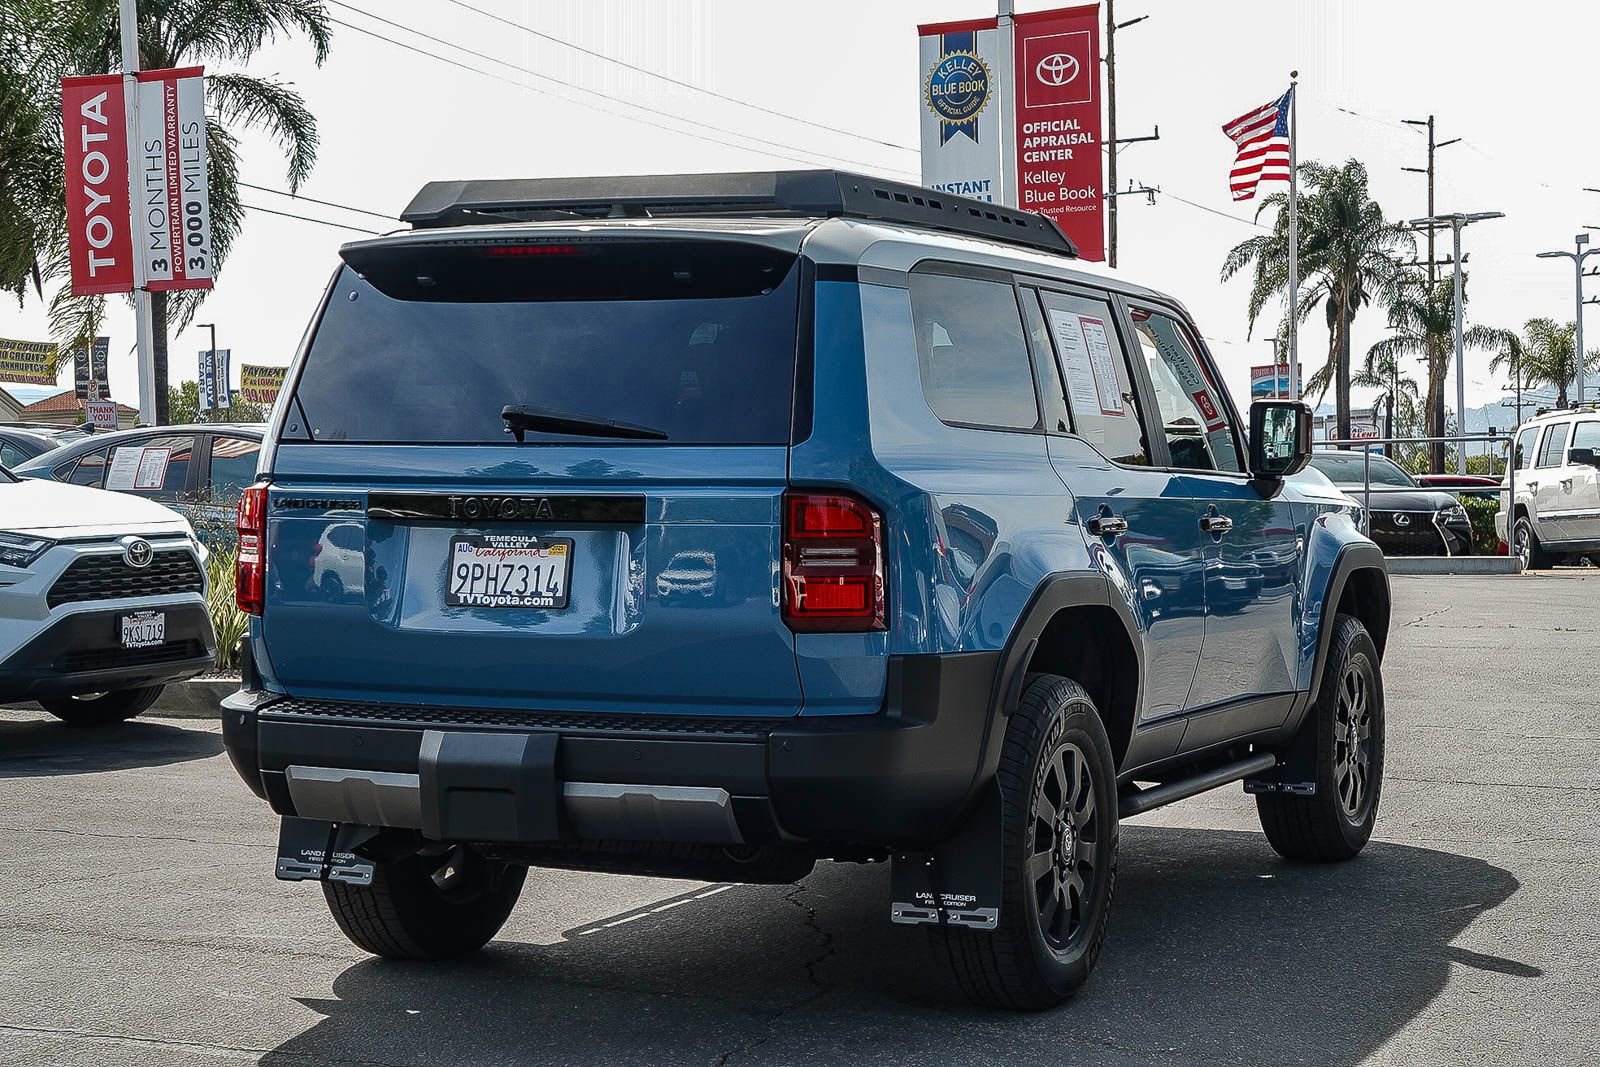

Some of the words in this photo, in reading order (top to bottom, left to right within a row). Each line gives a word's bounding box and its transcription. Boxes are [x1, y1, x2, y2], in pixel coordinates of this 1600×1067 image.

[937, 59, 982, 79] KELLEY
[932, 82, 957, 96] BLUE
[959, 79, 985, 93] BOOK
[937, 98, 963, 115] OFFICIAL
[963, 96, 980, 113] GUIDE
[166, 85, 177, 149] WARRANTY
[1023, 118, 1080, 134] OFFICIAL
[1023, 132, 1095, 149] APPRAISAL
[182, 121, 202, 192] MILES
[1024, 149, 1073, 163] CENTER
[169, 151, 178, 195] LIMITED
[1024, 171, 1066, 185] Kelley
[81, 91, 116, 277] TOYOTA
[145, 139, 167, 250] MONTHS
[1025, 189, 1056, 203] Blue
[1060, 186, 1096, 200] Book
[1040, 206, 1064, 214] Trusted
[1065, 204, 1097, 212] Resource
[171, 198, 183, 273] POWERTRAIN
[185, 201, 207, 270] 3,000
[152, 258, 168, 272] 3
[0, 361, 49, 373] ANKRUPTCY?
[206, 378, 214, 402] BUY
[88, 406, 115, 414] THANK
[92, 413, 112, 421] YOU!
[448, 497, 554, 519] TOYOTA
[484, 535, 538, 543] TEMECULA
[458, 544, 473, 553] AUG
[454, 563, 559, 597] 9PHZ314
[457, 593, 554, 607] TVToyota.com
[123, 623, 164, 643] 9KSL719
[300, 849, 321, 857] LAND
[321, 850, 356, 860] CUISER
